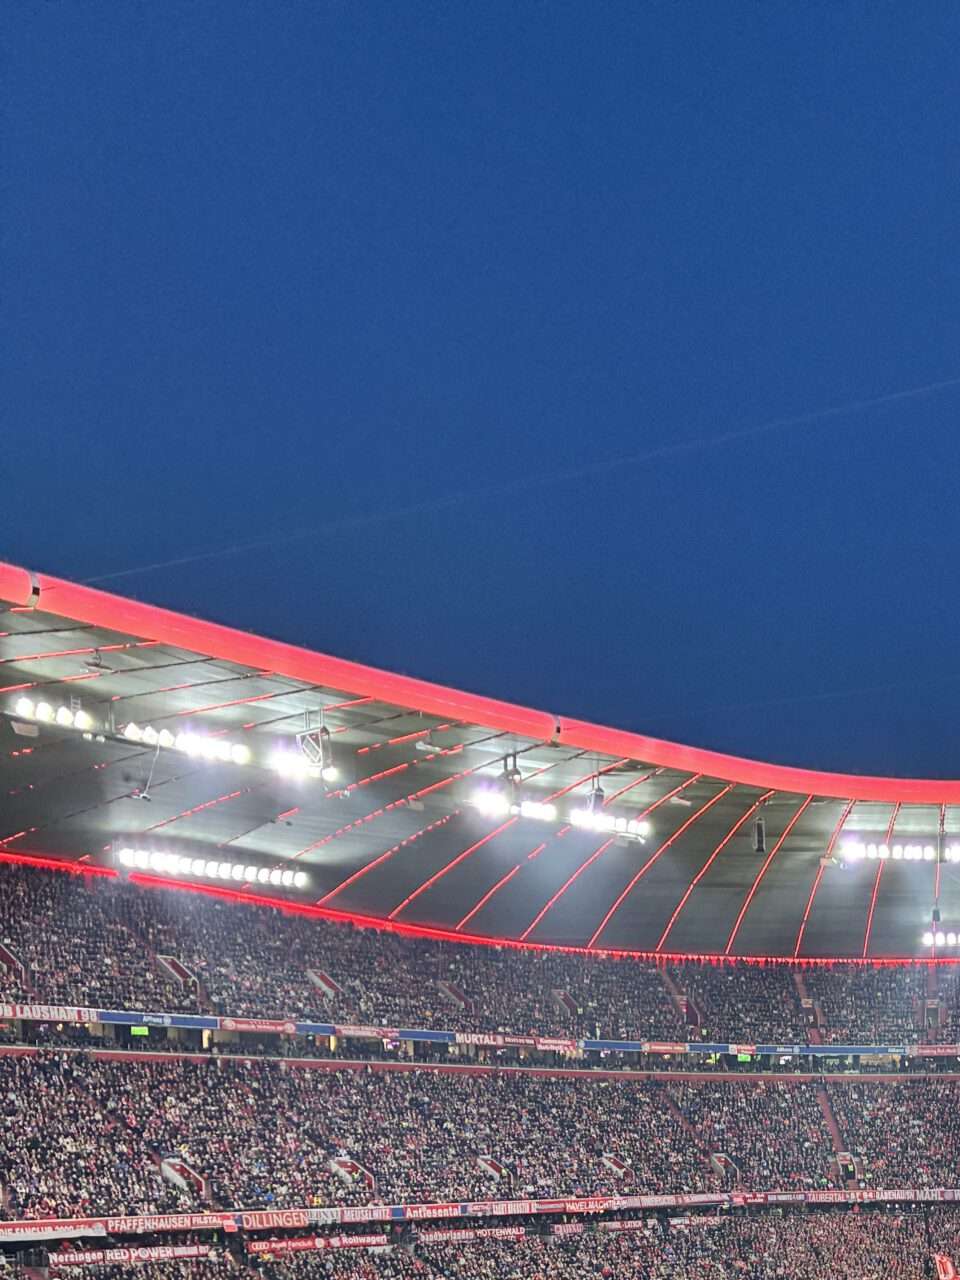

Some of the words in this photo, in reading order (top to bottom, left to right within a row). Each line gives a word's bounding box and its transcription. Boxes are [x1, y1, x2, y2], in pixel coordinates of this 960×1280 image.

[455, 1034, 496, 1045] MURTAL
[107, 1216, 191, 1232] PFAFFENHAUSEN
[242, 1212, 308, 1228] DILLINGEN
[106, 1248, 129, 1260] RED
[130, 1246, 173, 1259] POWER
